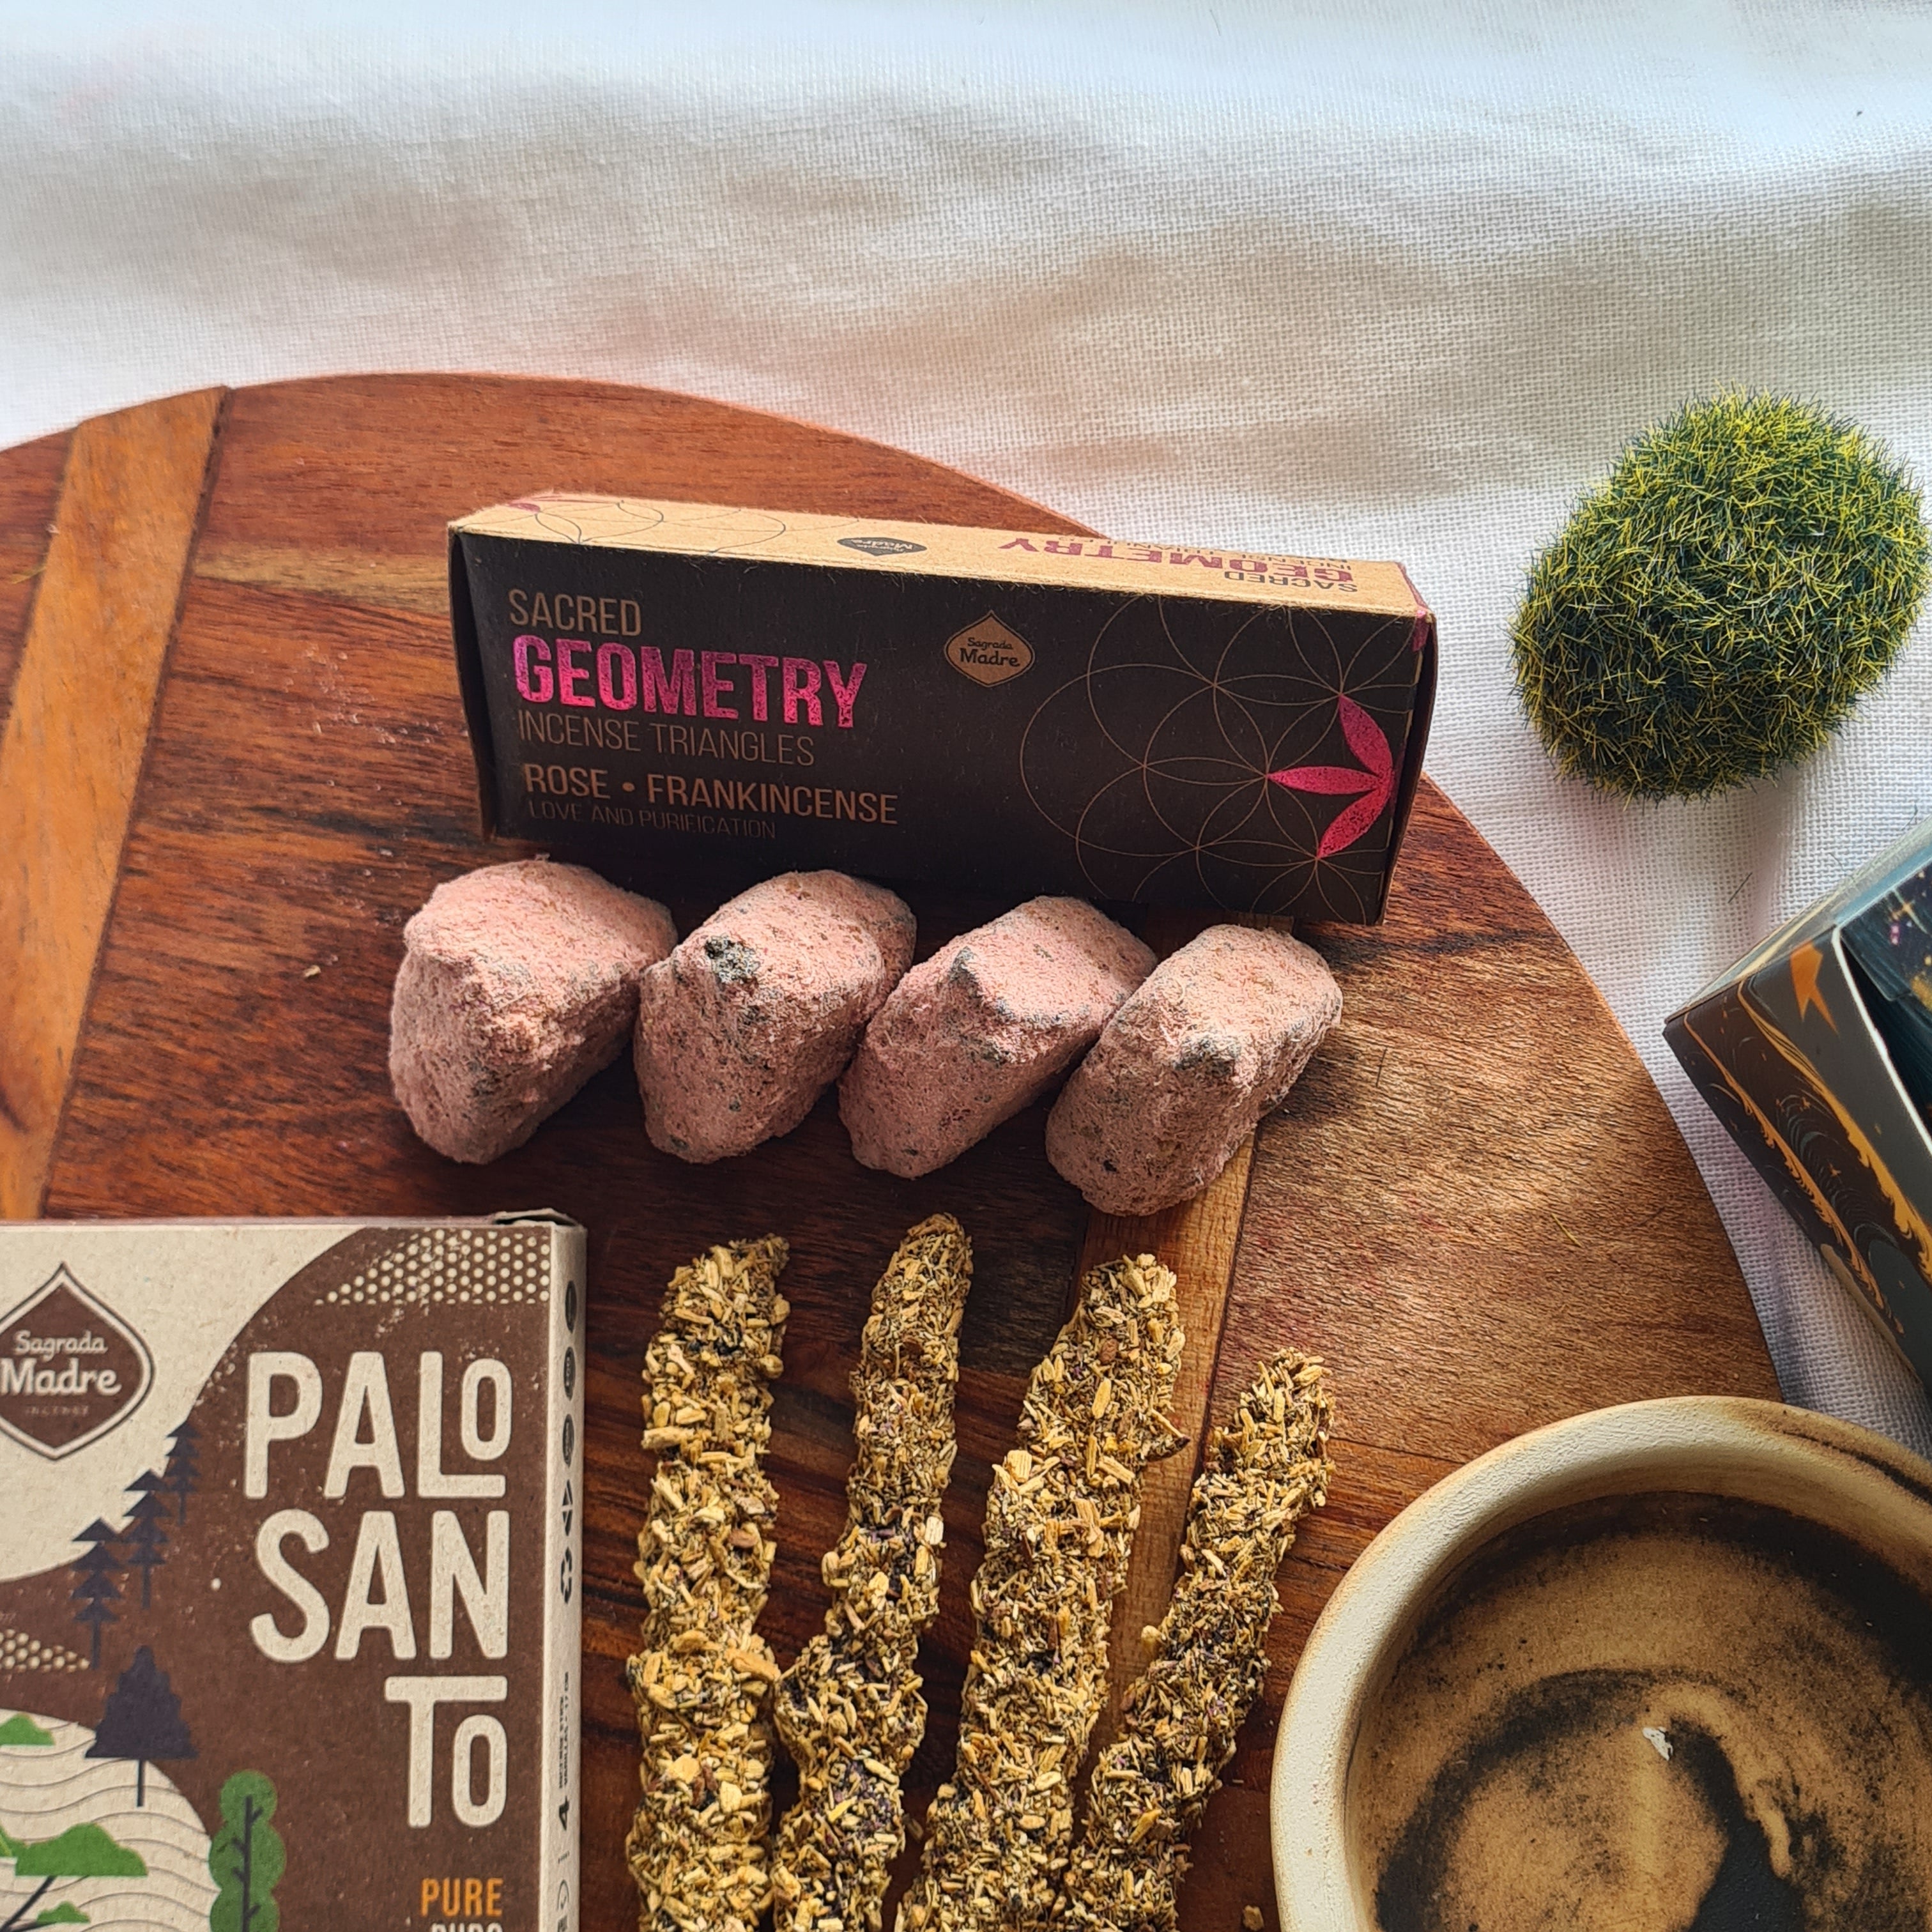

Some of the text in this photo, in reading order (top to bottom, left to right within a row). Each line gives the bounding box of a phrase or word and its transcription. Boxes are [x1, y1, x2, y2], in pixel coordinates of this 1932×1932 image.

[998, 538, 1353, 582] GEOMETRY
[1224, 571, 1358, 592] SACRED
[509, 588, 641, 636] SACRED
[960, 648, 1020, 666] Madre
[967, 638, 1013, 650] Sagrada
[513, 634, 867, 728] GEOMETRY
[518, 709, 815, 767] INCENSE TRIANGLES
[523, 763, 898, 824] ROSE FRANKINCENSE
[528, 800, 776, 839] LOVE AND PURIFICATION
[15, 1329, 108, 1362] Sagrada
[0, 1358, 122, 1396] Madre
[244, 1351, 512, 1499] PALO
[249, 1509, 510, 1662] SAN
[384, 1675, 508, 1828] TO
[558, 1796, 569, 1831] 4
[420, 1877, 503, 1917] PURE
